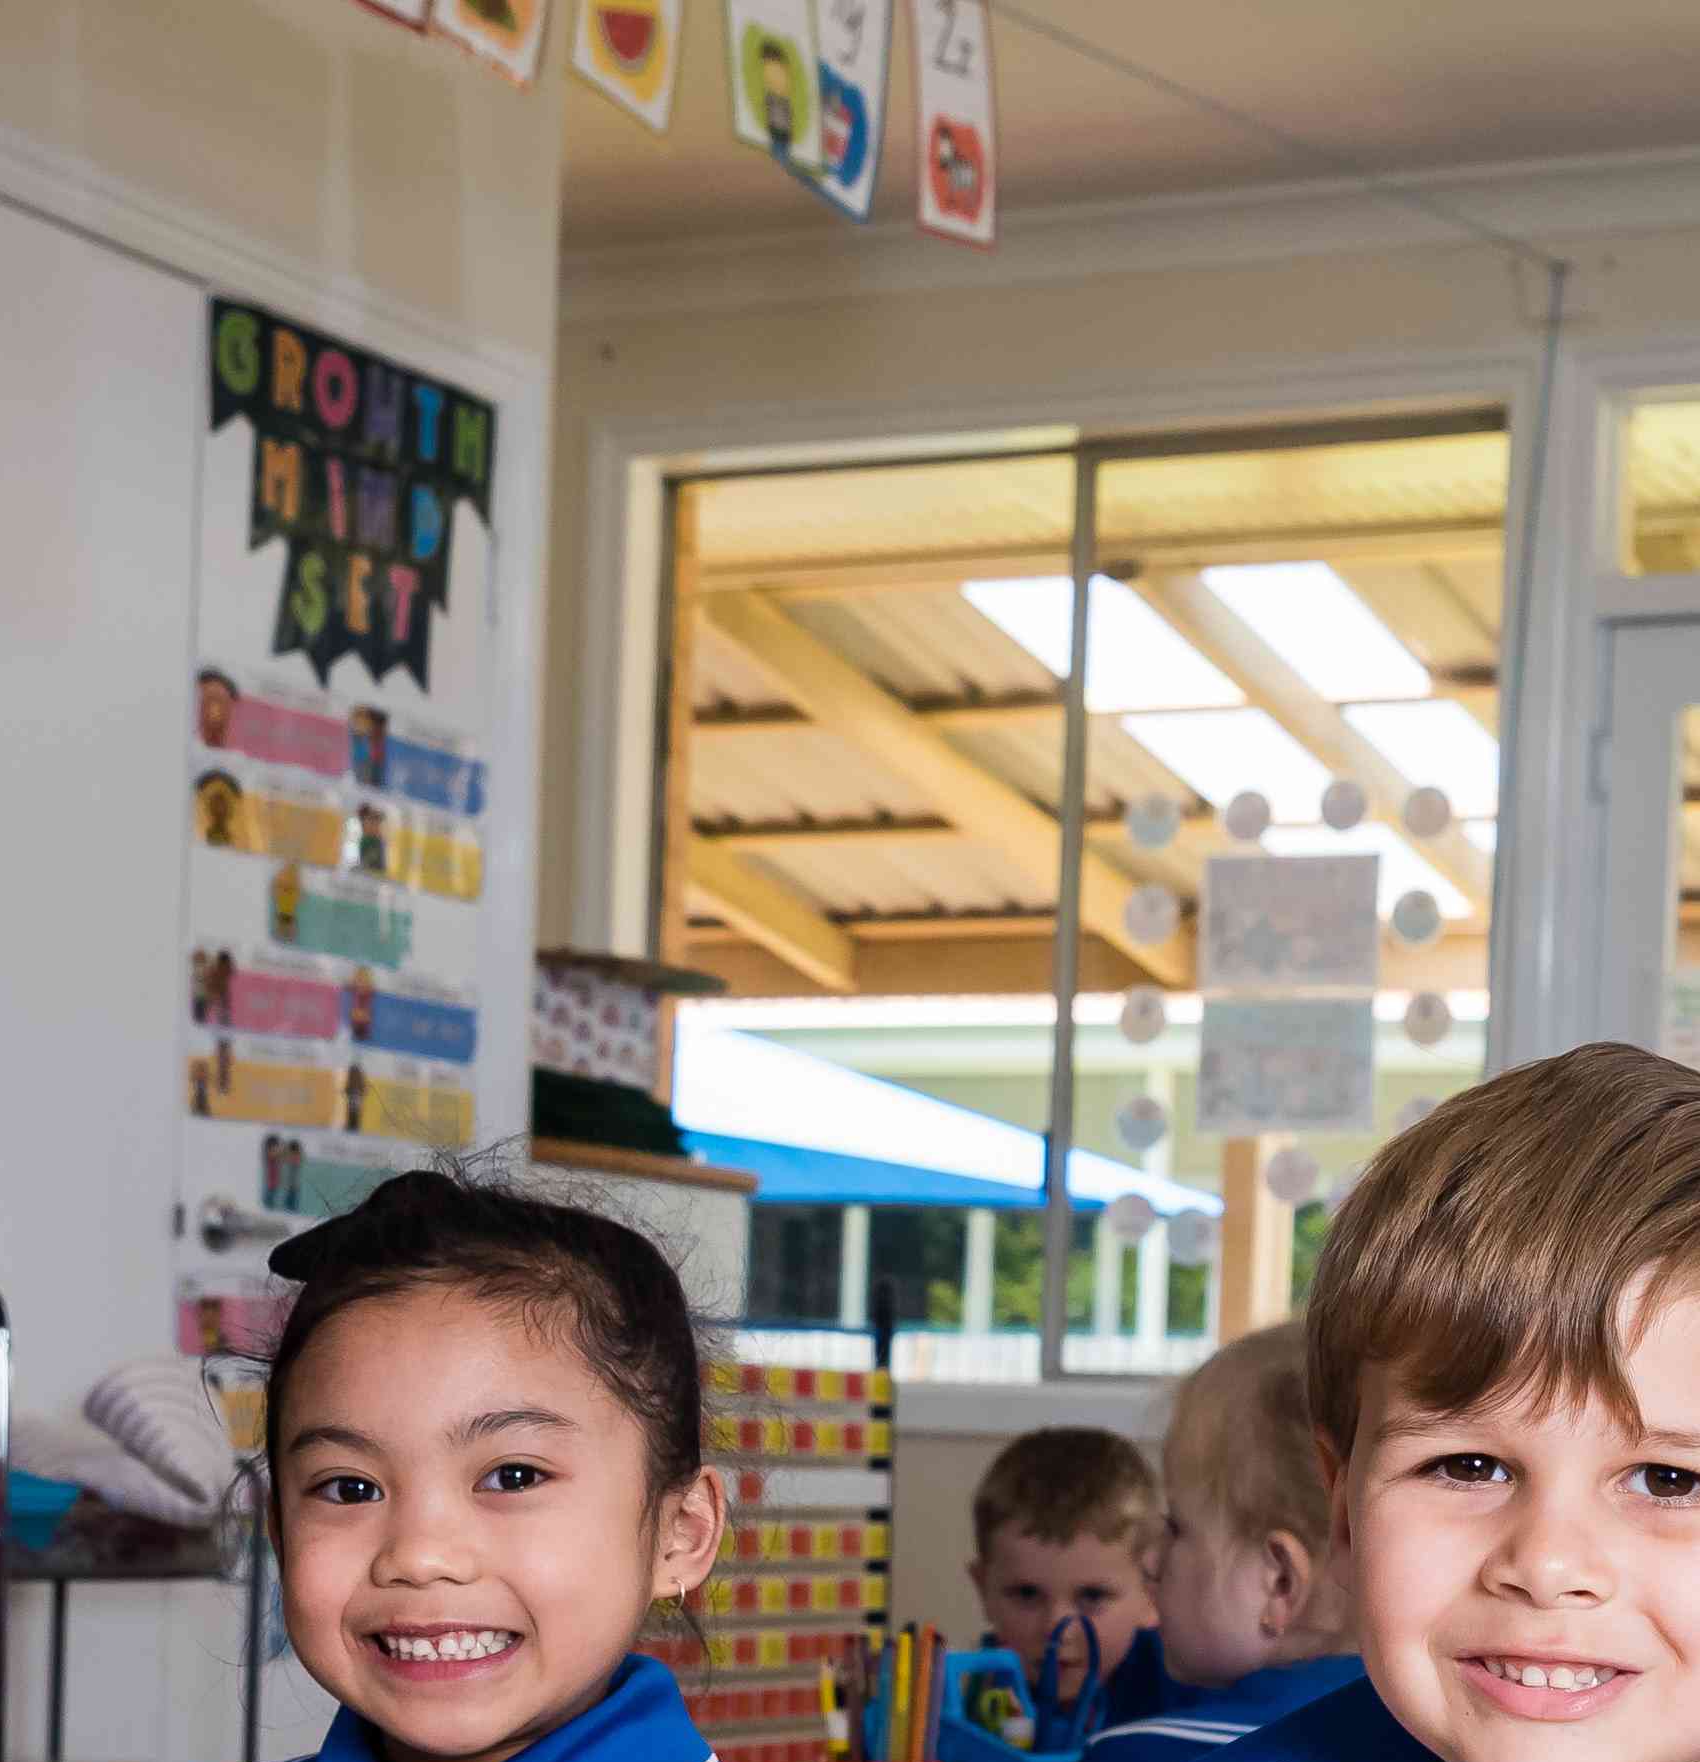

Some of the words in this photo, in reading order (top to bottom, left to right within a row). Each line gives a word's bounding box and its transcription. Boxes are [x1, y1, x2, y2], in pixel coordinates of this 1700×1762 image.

[215, 310, 487, 482] GROWTH
[260, 442, 445, 562] MIND
[292, 552, 420, 641] SET
